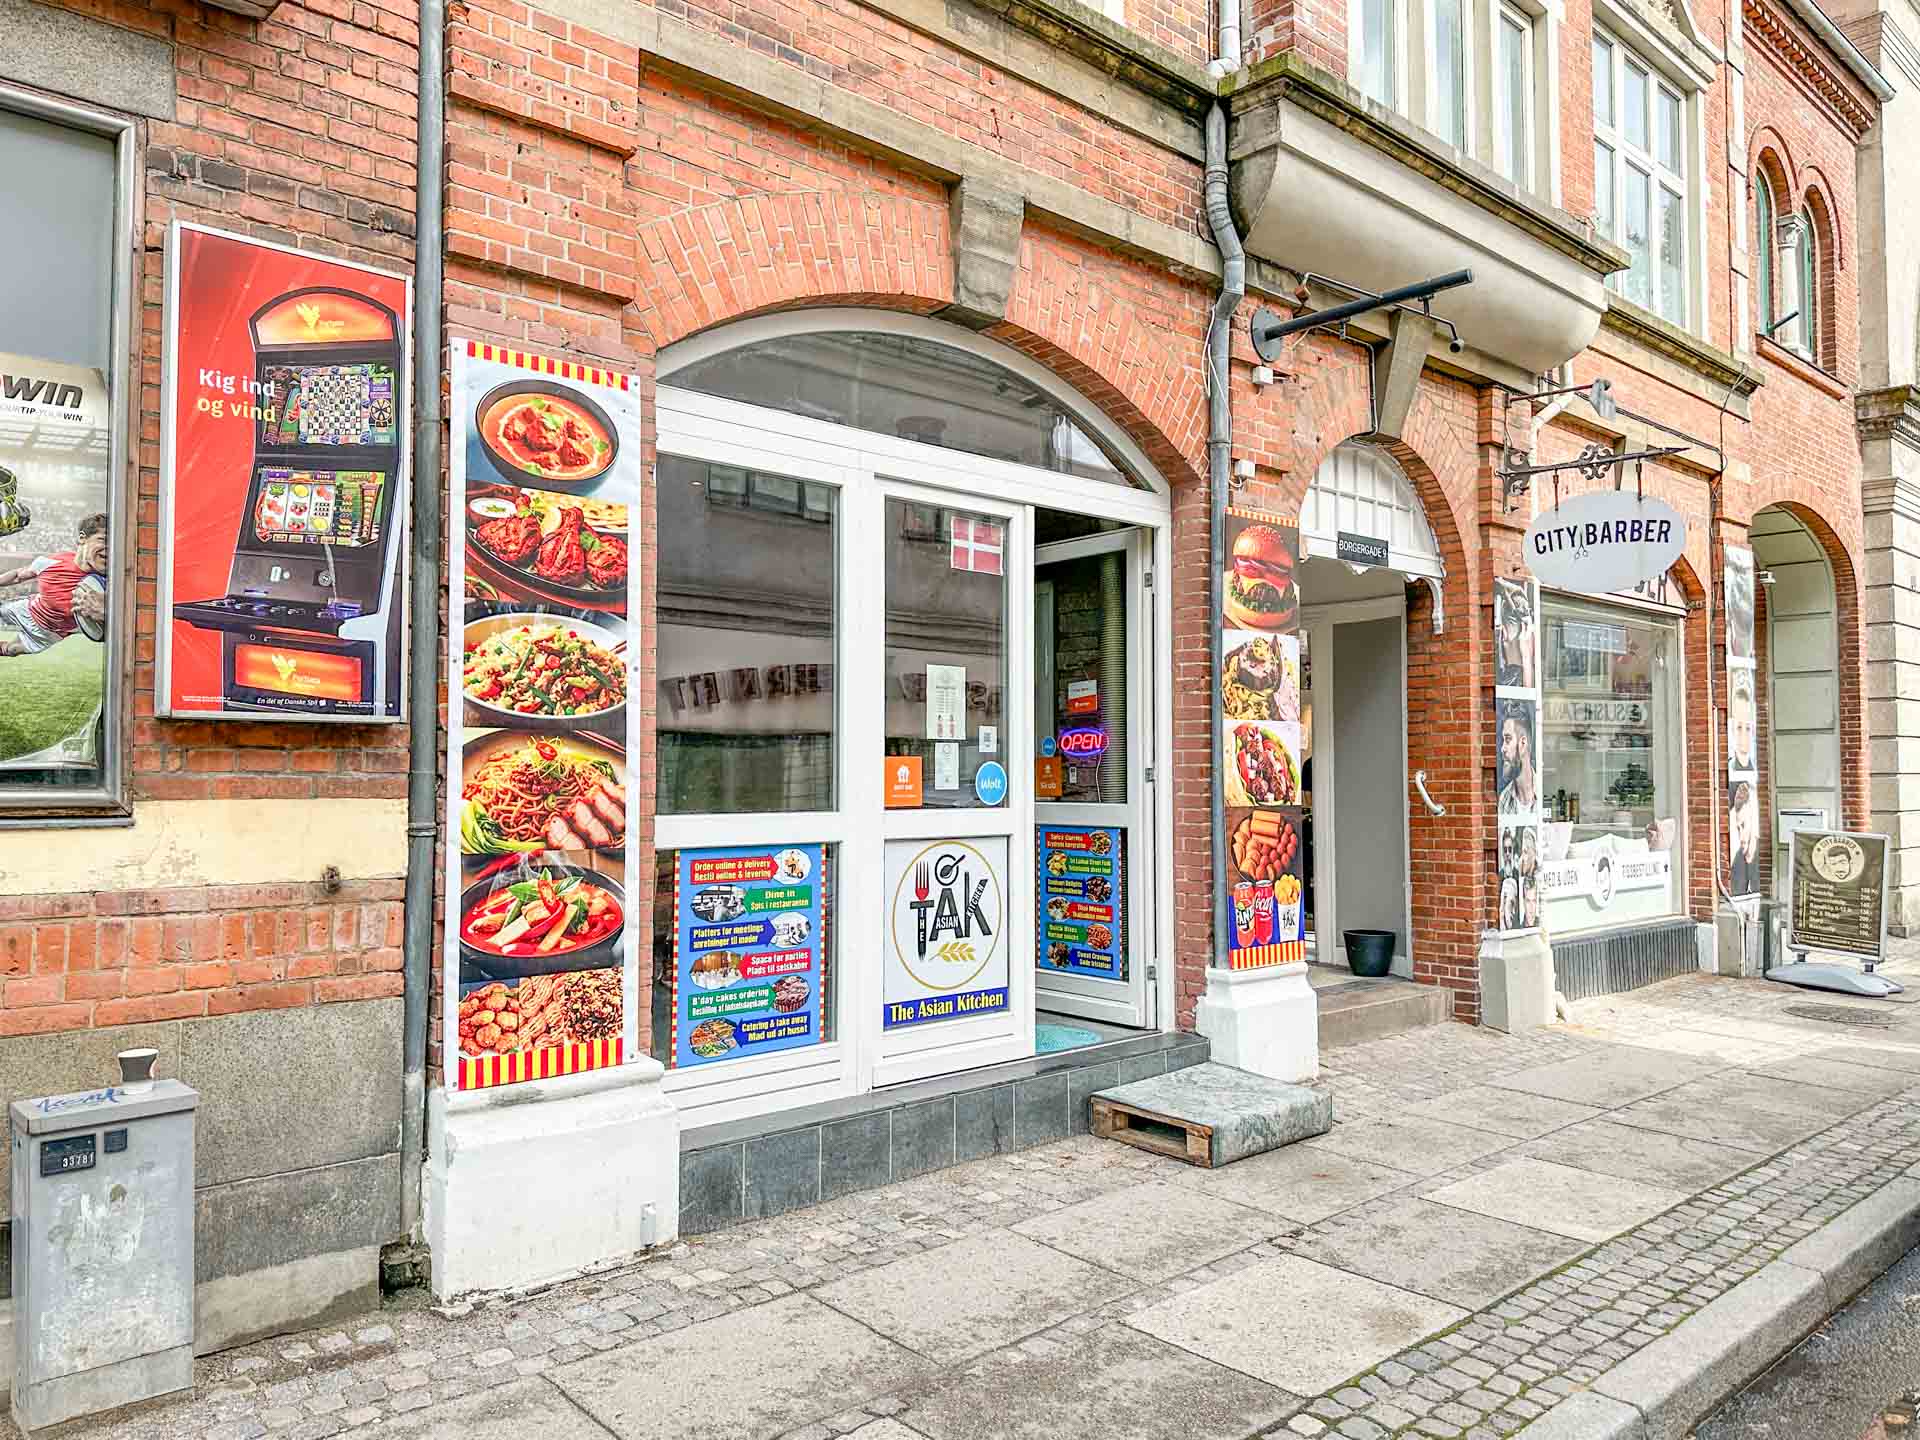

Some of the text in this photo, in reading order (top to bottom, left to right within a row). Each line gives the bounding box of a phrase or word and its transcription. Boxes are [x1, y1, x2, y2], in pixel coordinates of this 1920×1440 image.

[199, 368, 276, 397] Kig ind
[198, 397, 276, 422] og vind
[1534, 518, 1672, 555] CITY BARBER
[1339, 539, 1387, 558] BORGERGADE 9
[1061, 733, 1103, 750] OPEN
[980, 778, 1002, 789] Wolt
[694, 859, 770, 871] Order online & delivery
[737, 870, 743, 879] &
[744, 869, 771, 878] levering
[765, 889, 795, 899] Dine in
[966, 883, 986, 919] KITCHEN
[751, 902, 764, 910] Spis
[935, 915, 959, 930] ASIAN
[693, 927, 720, 938] Platters
[722, 925, 732, 935] for
[751, 951, 808, 966] Space for parties
[747, 962, 808, 976] Plads til selskaber
[692, 988, 769, 1006] B'day cakes ordering
[889, 992, 1003, 1022] The Asian Kitchen
[741, 1015, 808, 1032] Catering & take away
[748, 1031, 766, 1041] Mad
[777, 1029, 785, 1038] af
[786, 1025, 808, 1036] huset
